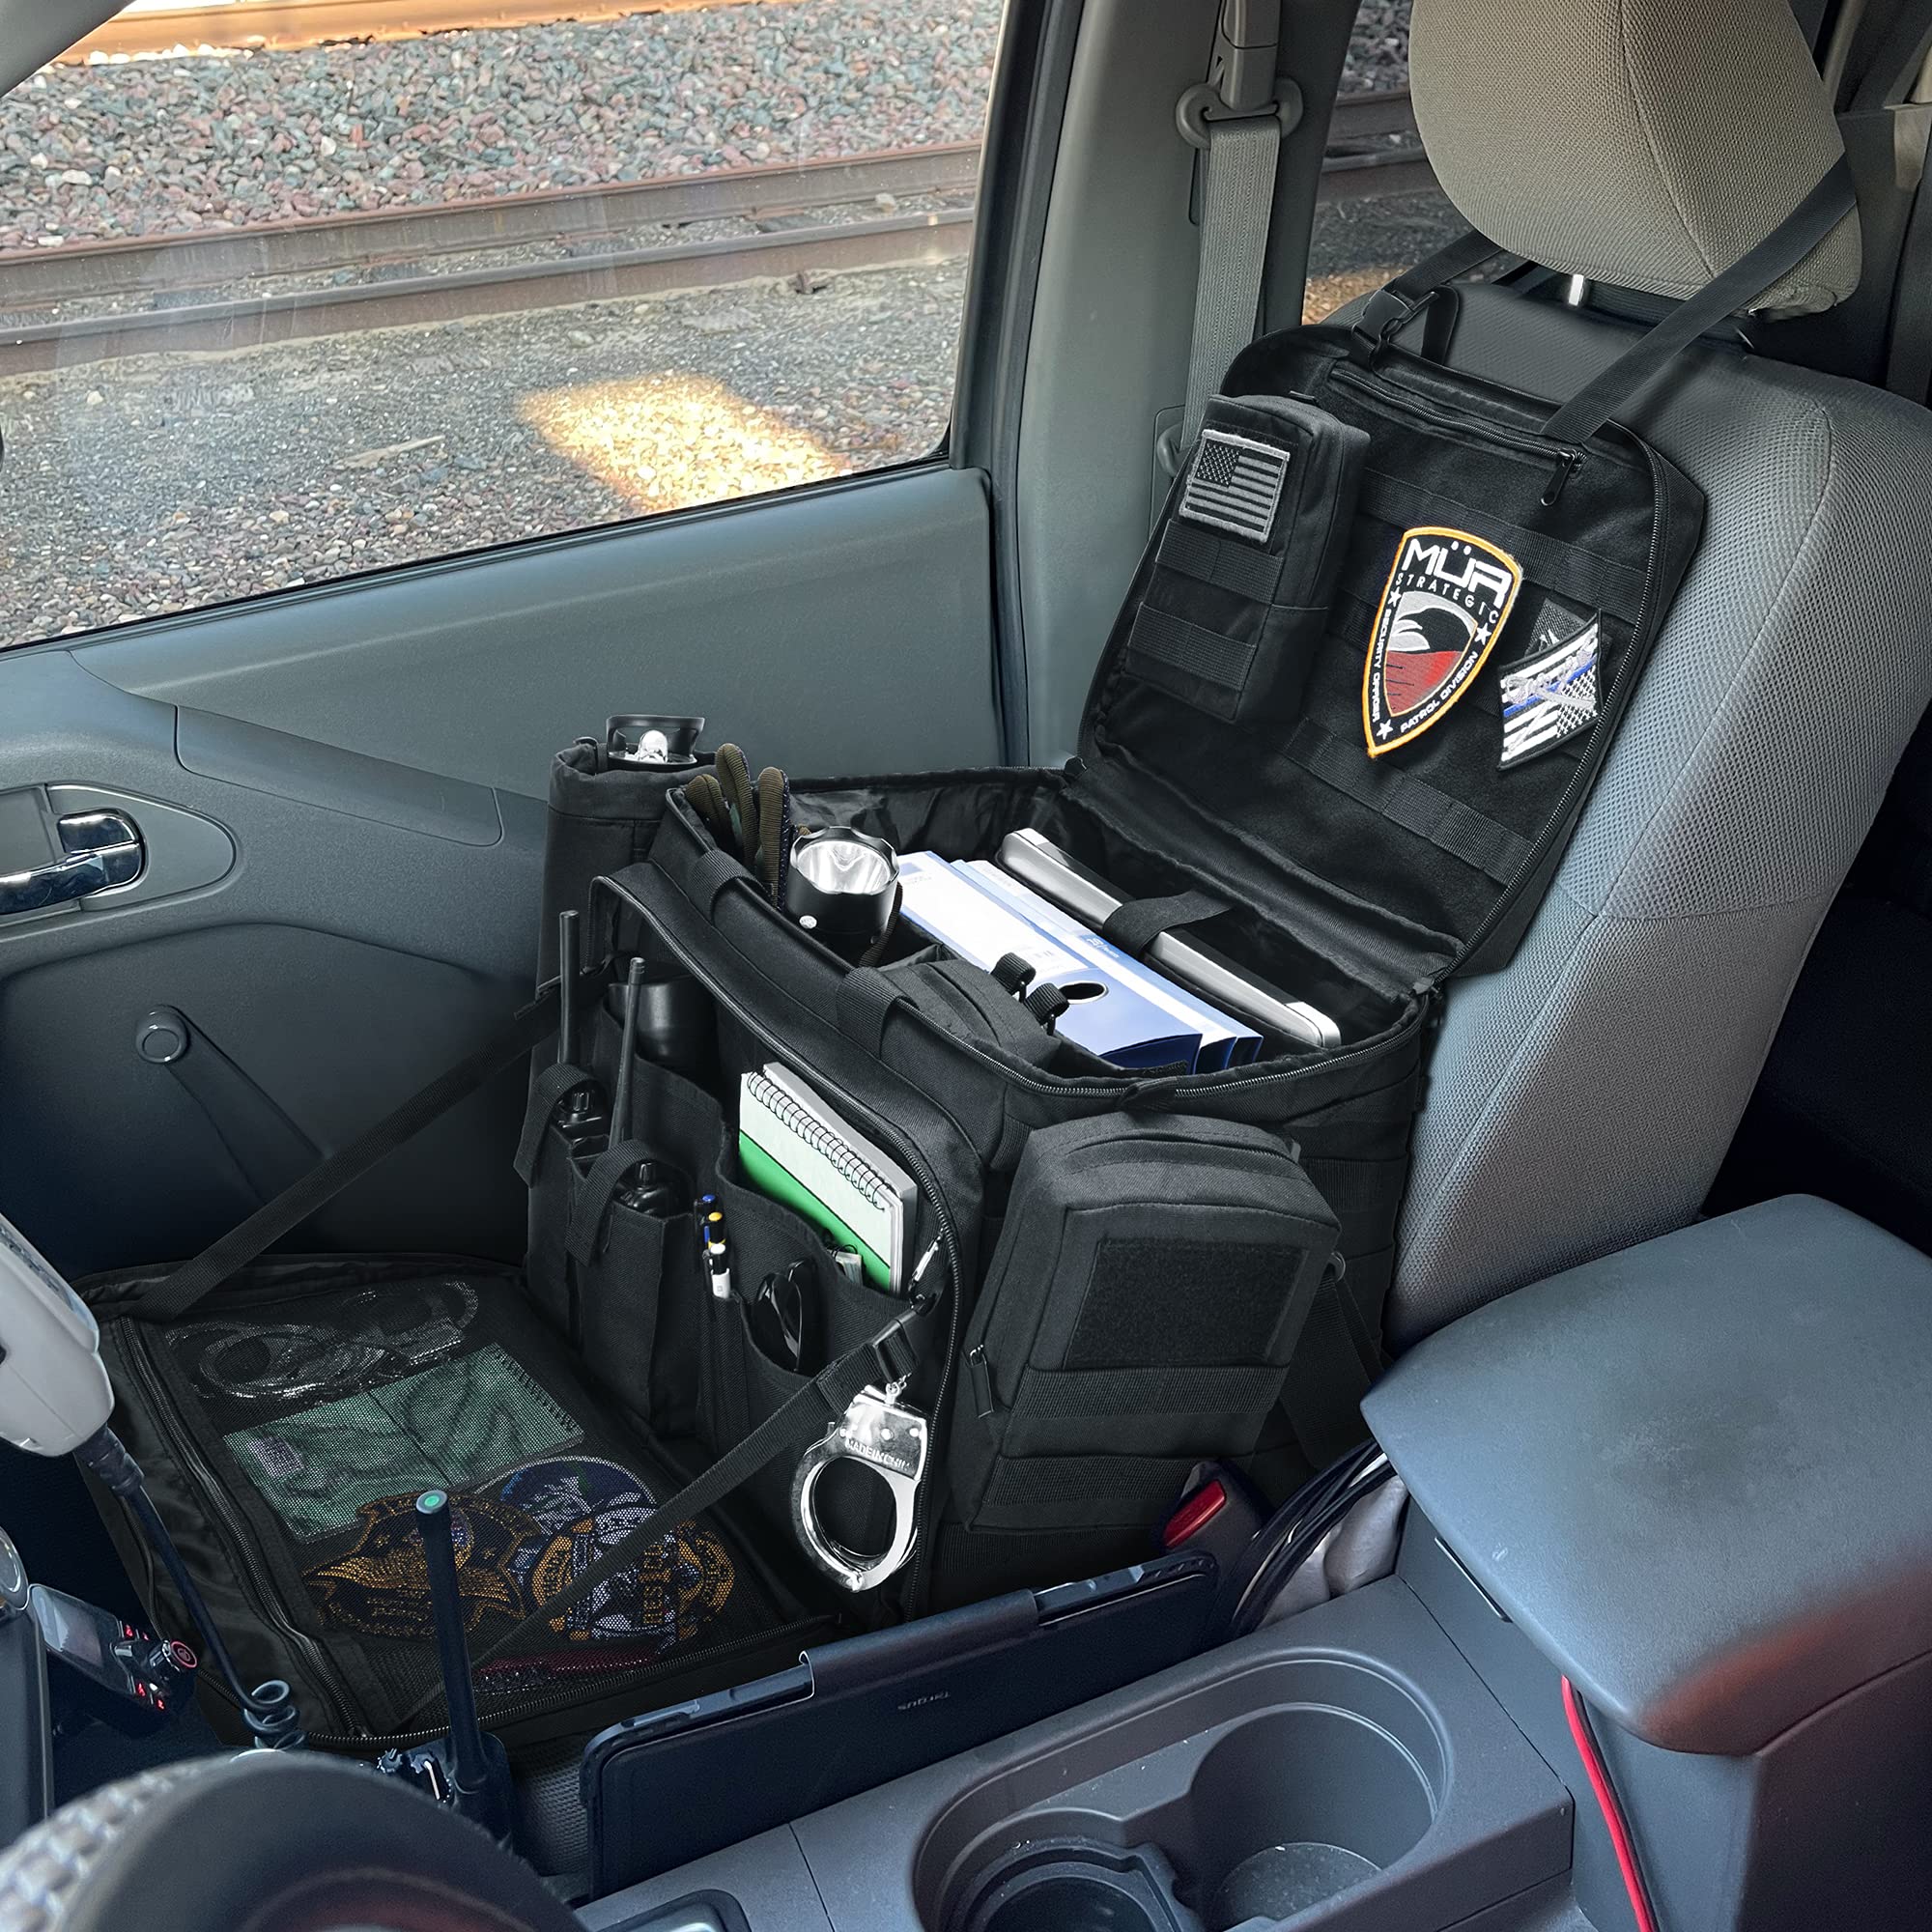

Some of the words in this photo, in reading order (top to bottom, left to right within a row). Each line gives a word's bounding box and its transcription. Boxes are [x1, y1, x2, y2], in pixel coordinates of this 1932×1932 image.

[1395, 572, 1499, 624] STRATEGIC
[1374, 609, 1392, 668] SECURITY
[1372, 671, 1381, 723] OFFICER
[1401, 699, 1440, 733] PATROL
[1439, 651, 1479, 700] DIVISION
[845, 1438, 873, 1456] MADE
